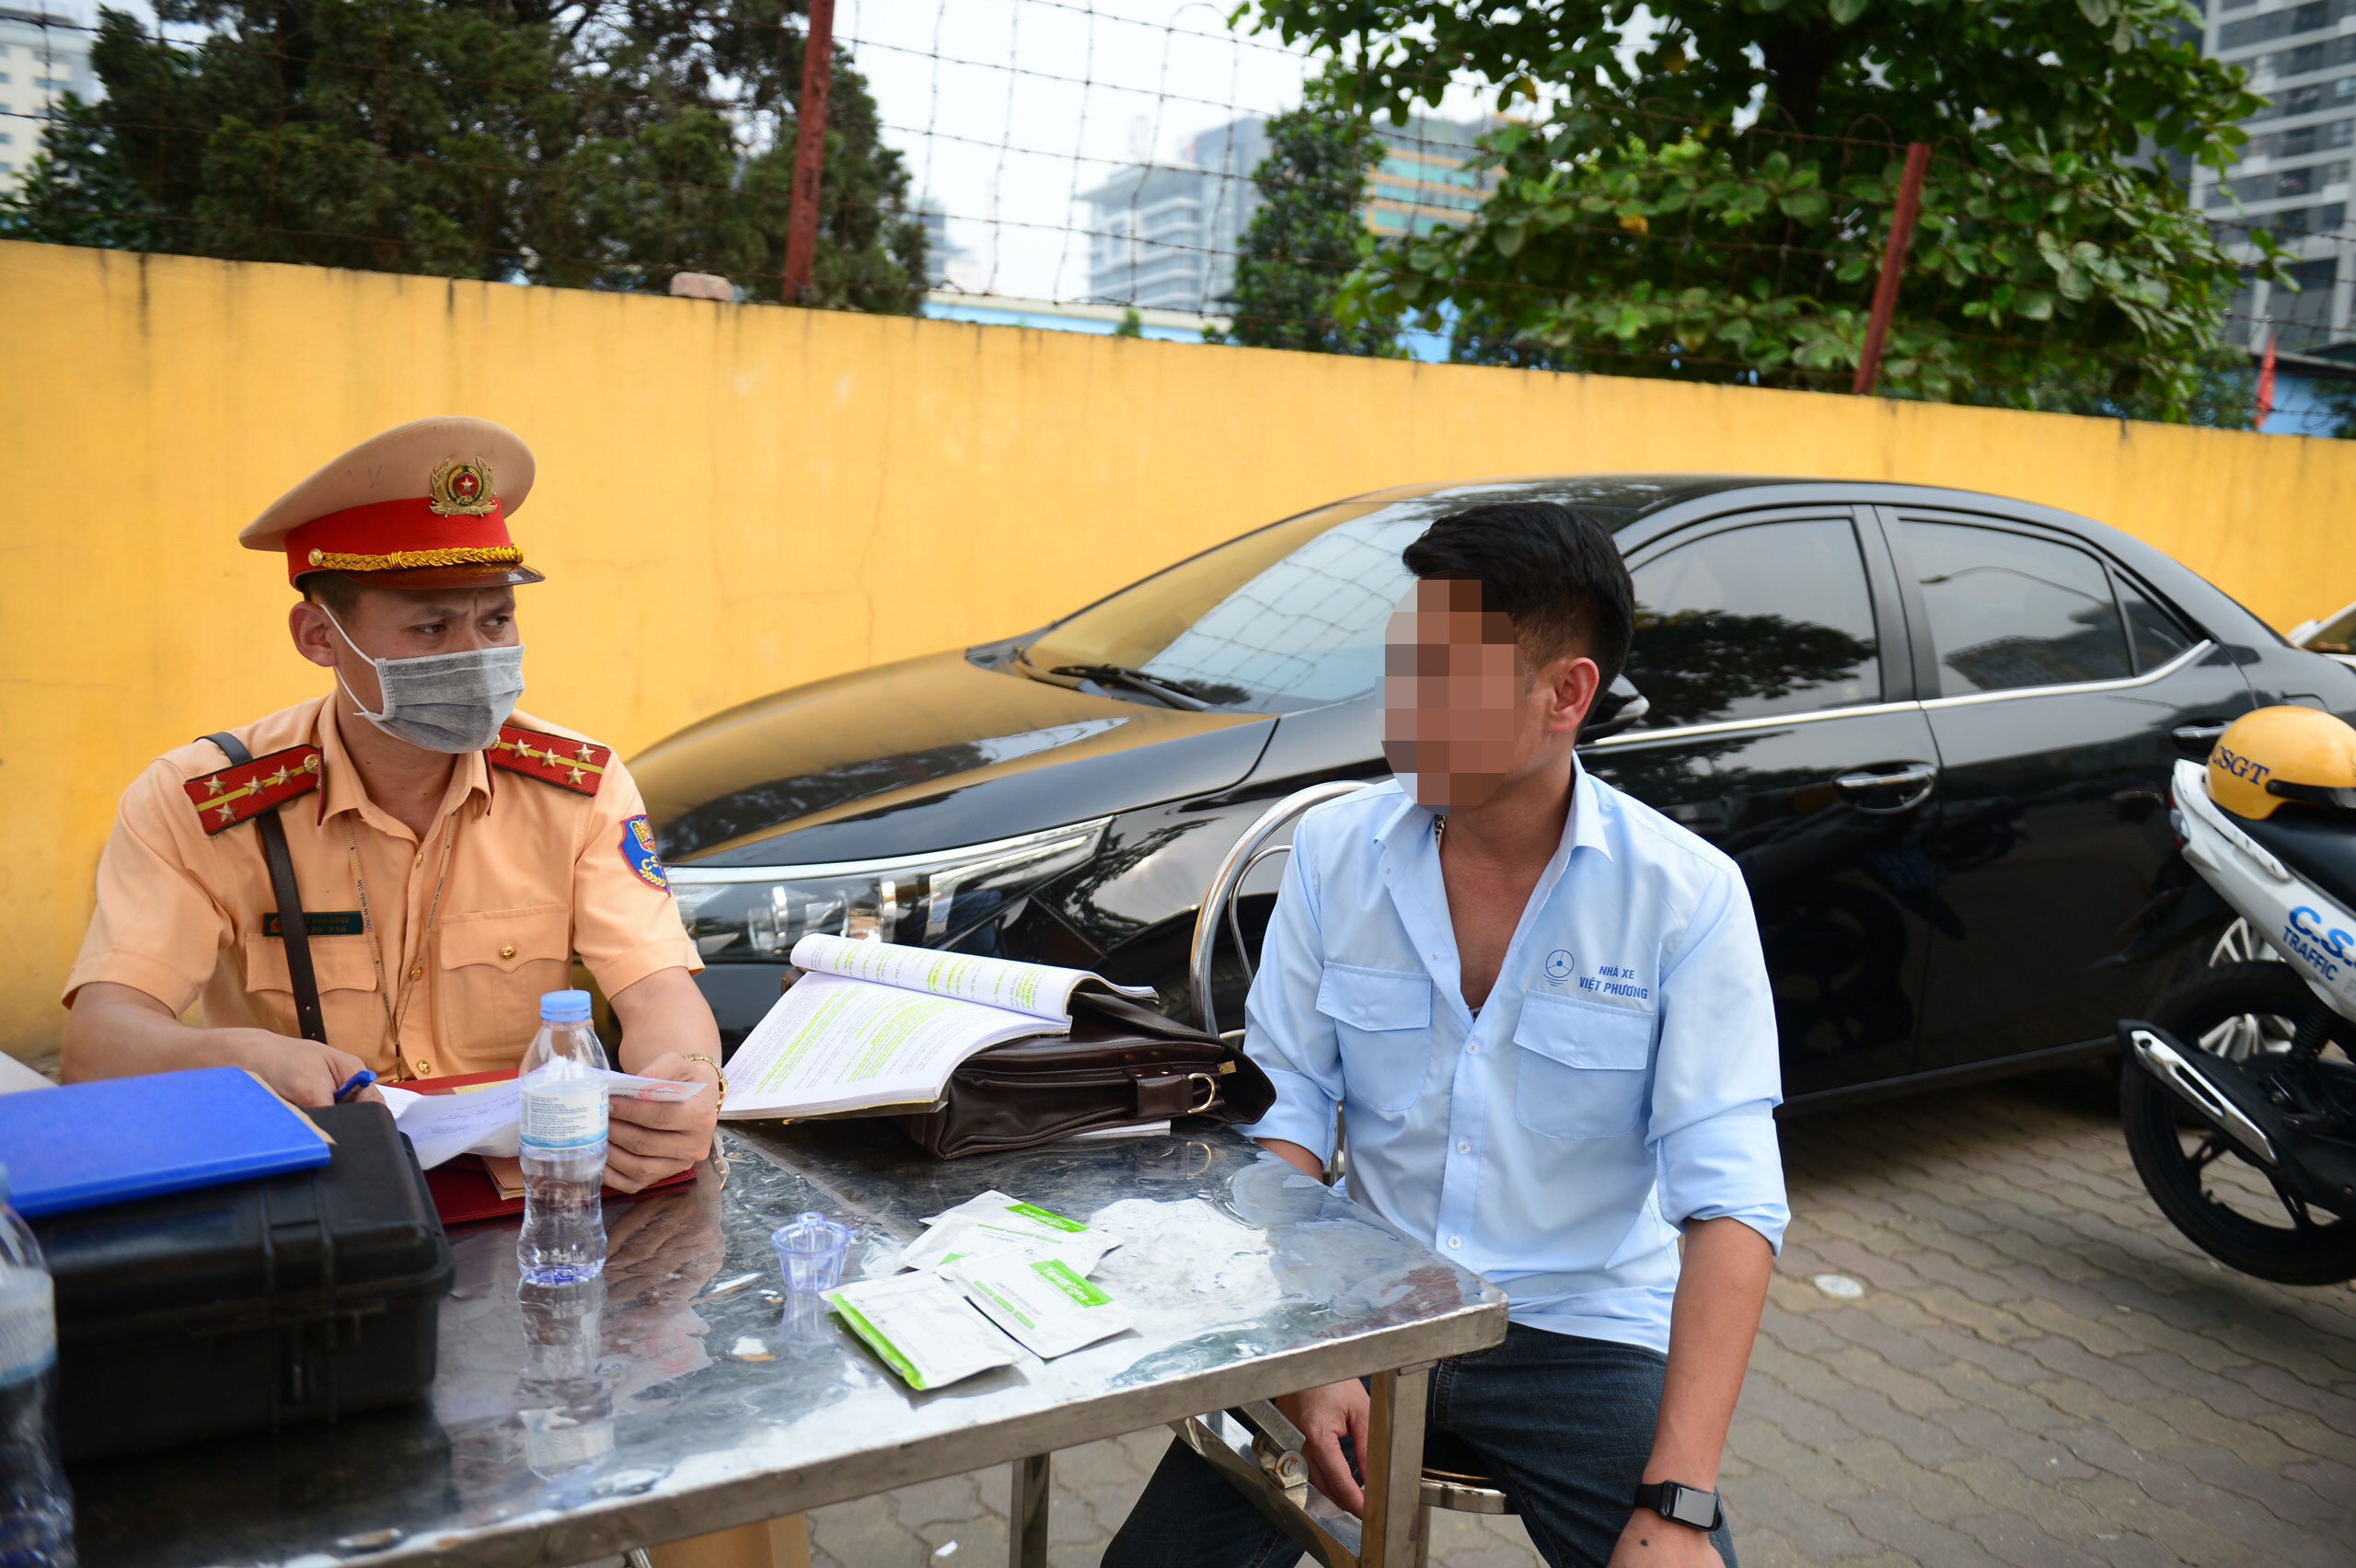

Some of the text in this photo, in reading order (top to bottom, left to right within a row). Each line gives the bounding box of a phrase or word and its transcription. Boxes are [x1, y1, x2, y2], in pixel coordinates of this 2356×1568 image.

[2212, 745, 2270, 786] CSGT
[2283, 926, 2339, 982] TRAFFIC
[1579, 976, 1648, 1000] VIỆT PHƯƠNG
[1599, 965, 1635, 980] NHÀ XE
